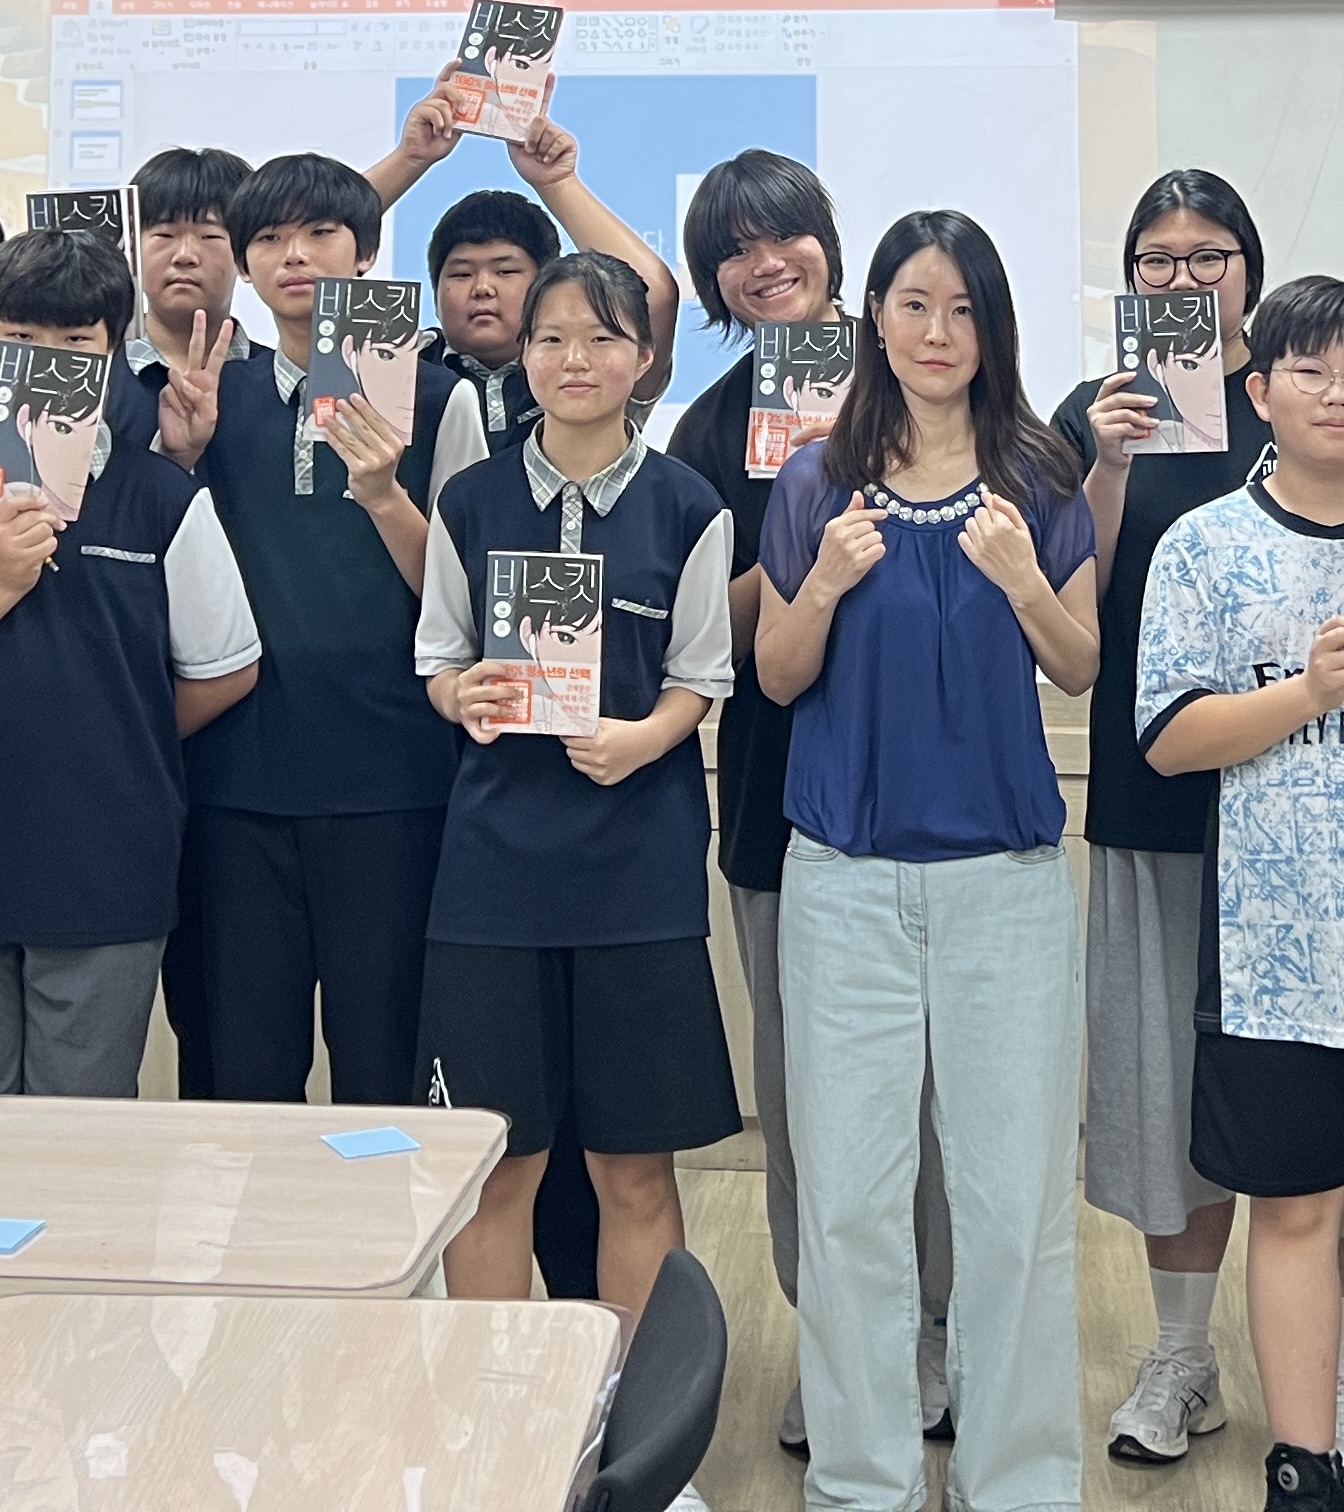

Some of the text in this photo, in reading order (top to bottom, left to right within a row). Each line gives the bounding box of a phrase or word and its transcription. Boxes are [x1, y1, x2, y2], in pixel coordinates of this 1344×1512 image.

[471, 2, 558, 42] 비스킷
[30, 194, 118, 234] 비스킷
[318, 281, 417, 324] 비스킷
[1119, 295, 1213, 338] 비스킷
[759, 325, 851, 365] 비스킷
[493, 558, 597, 605] 비스킷
